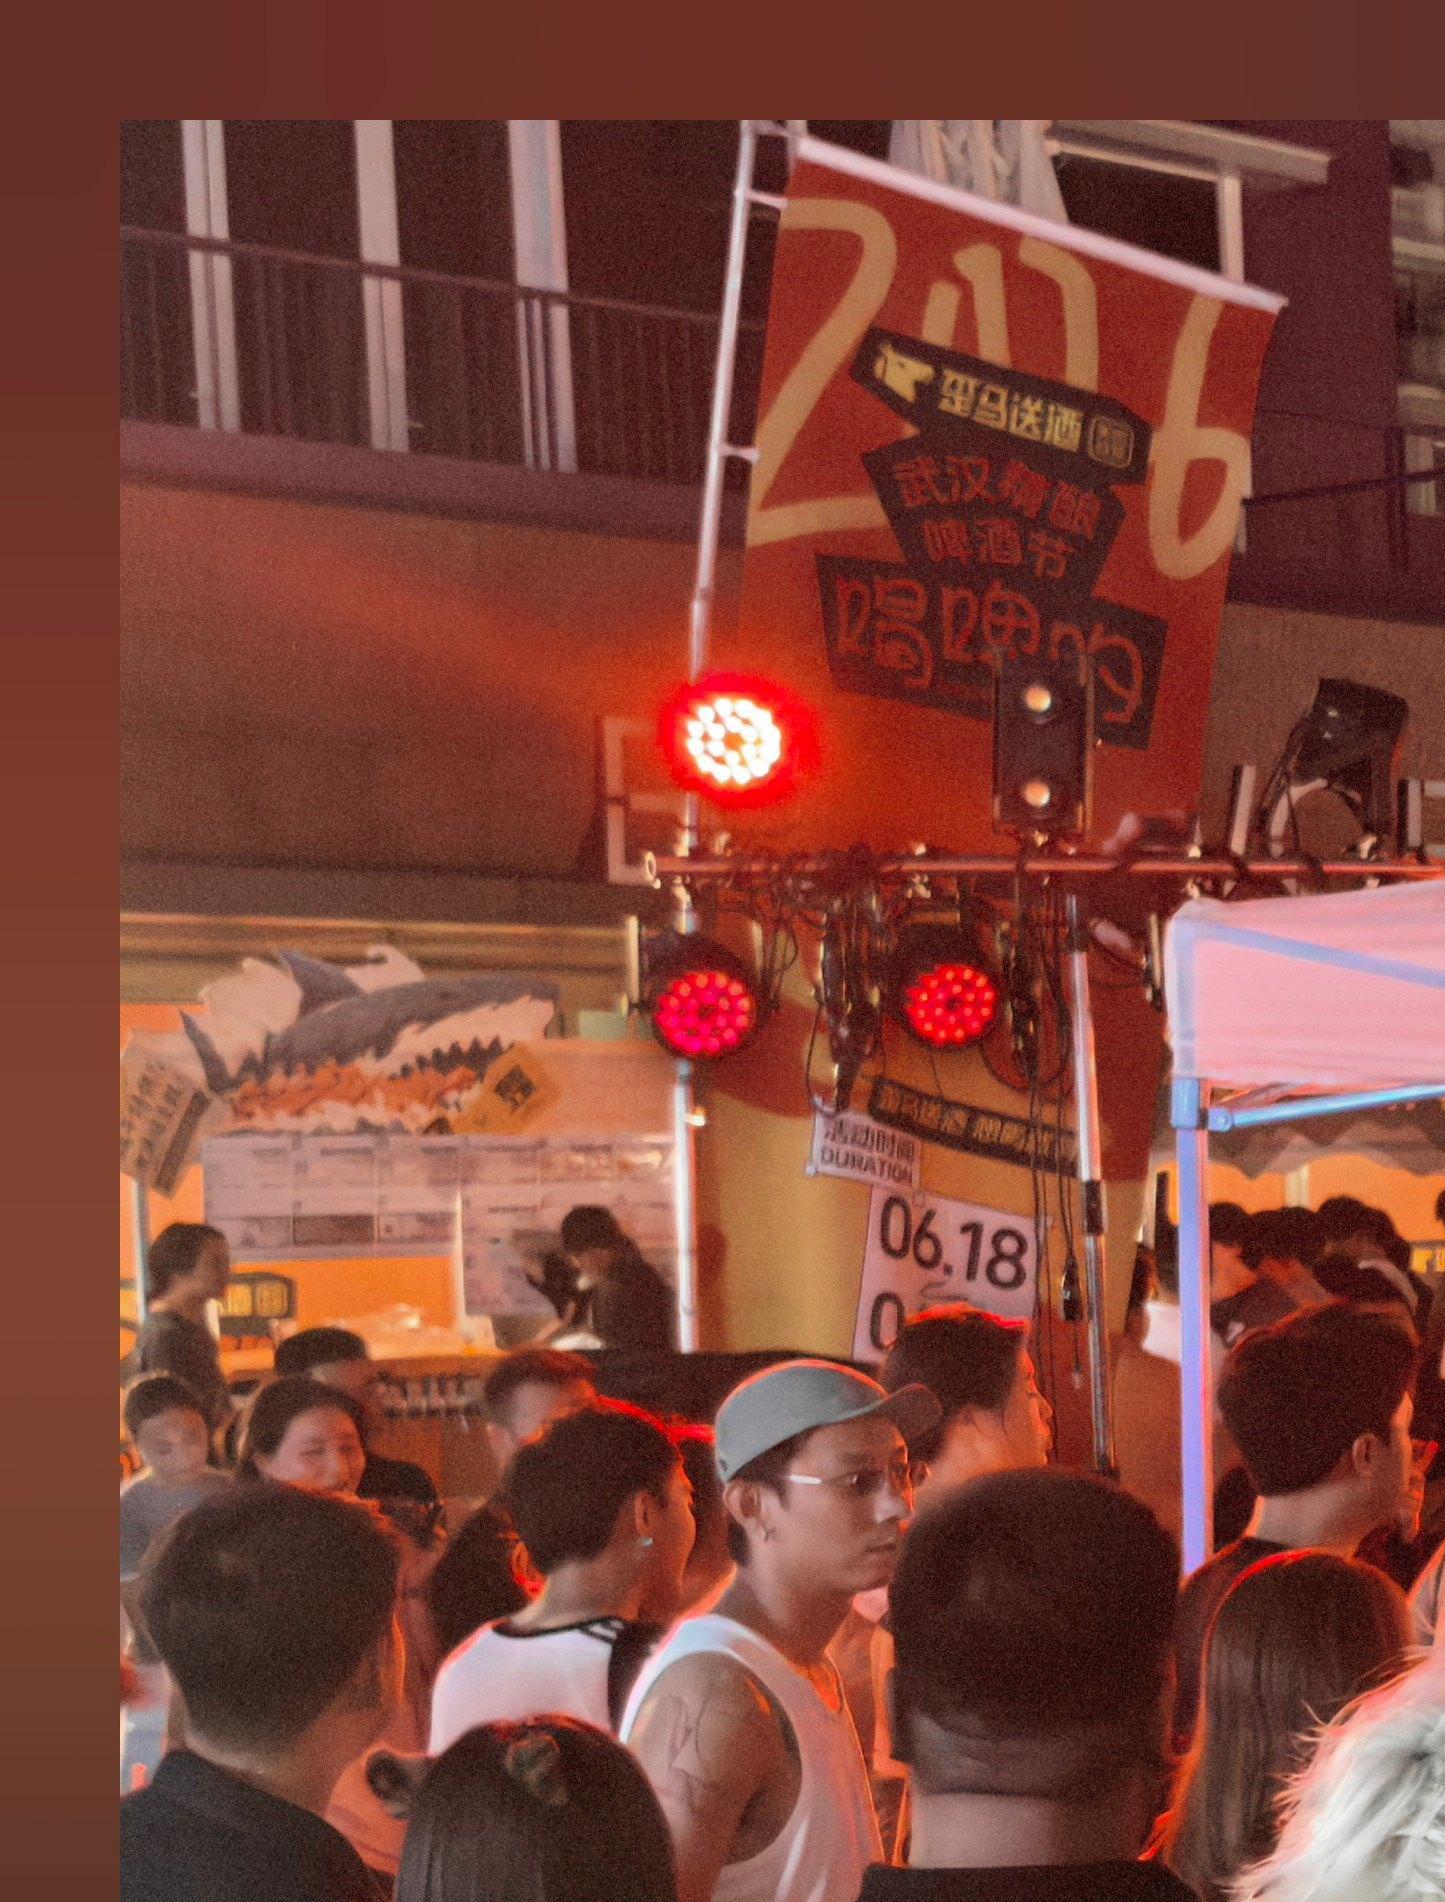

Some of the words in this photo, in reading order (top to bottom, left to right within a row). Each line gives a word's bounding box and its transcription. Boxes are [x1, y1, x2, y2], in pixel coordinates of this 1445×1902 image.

[938, 366, 1084, 453] 歪马送酒
[894, 455, 1103, 543] 武汉精酿
[921, 517, 1076, 579] 啤酒节
[880, 1195, 1029, 1291] 06.18
